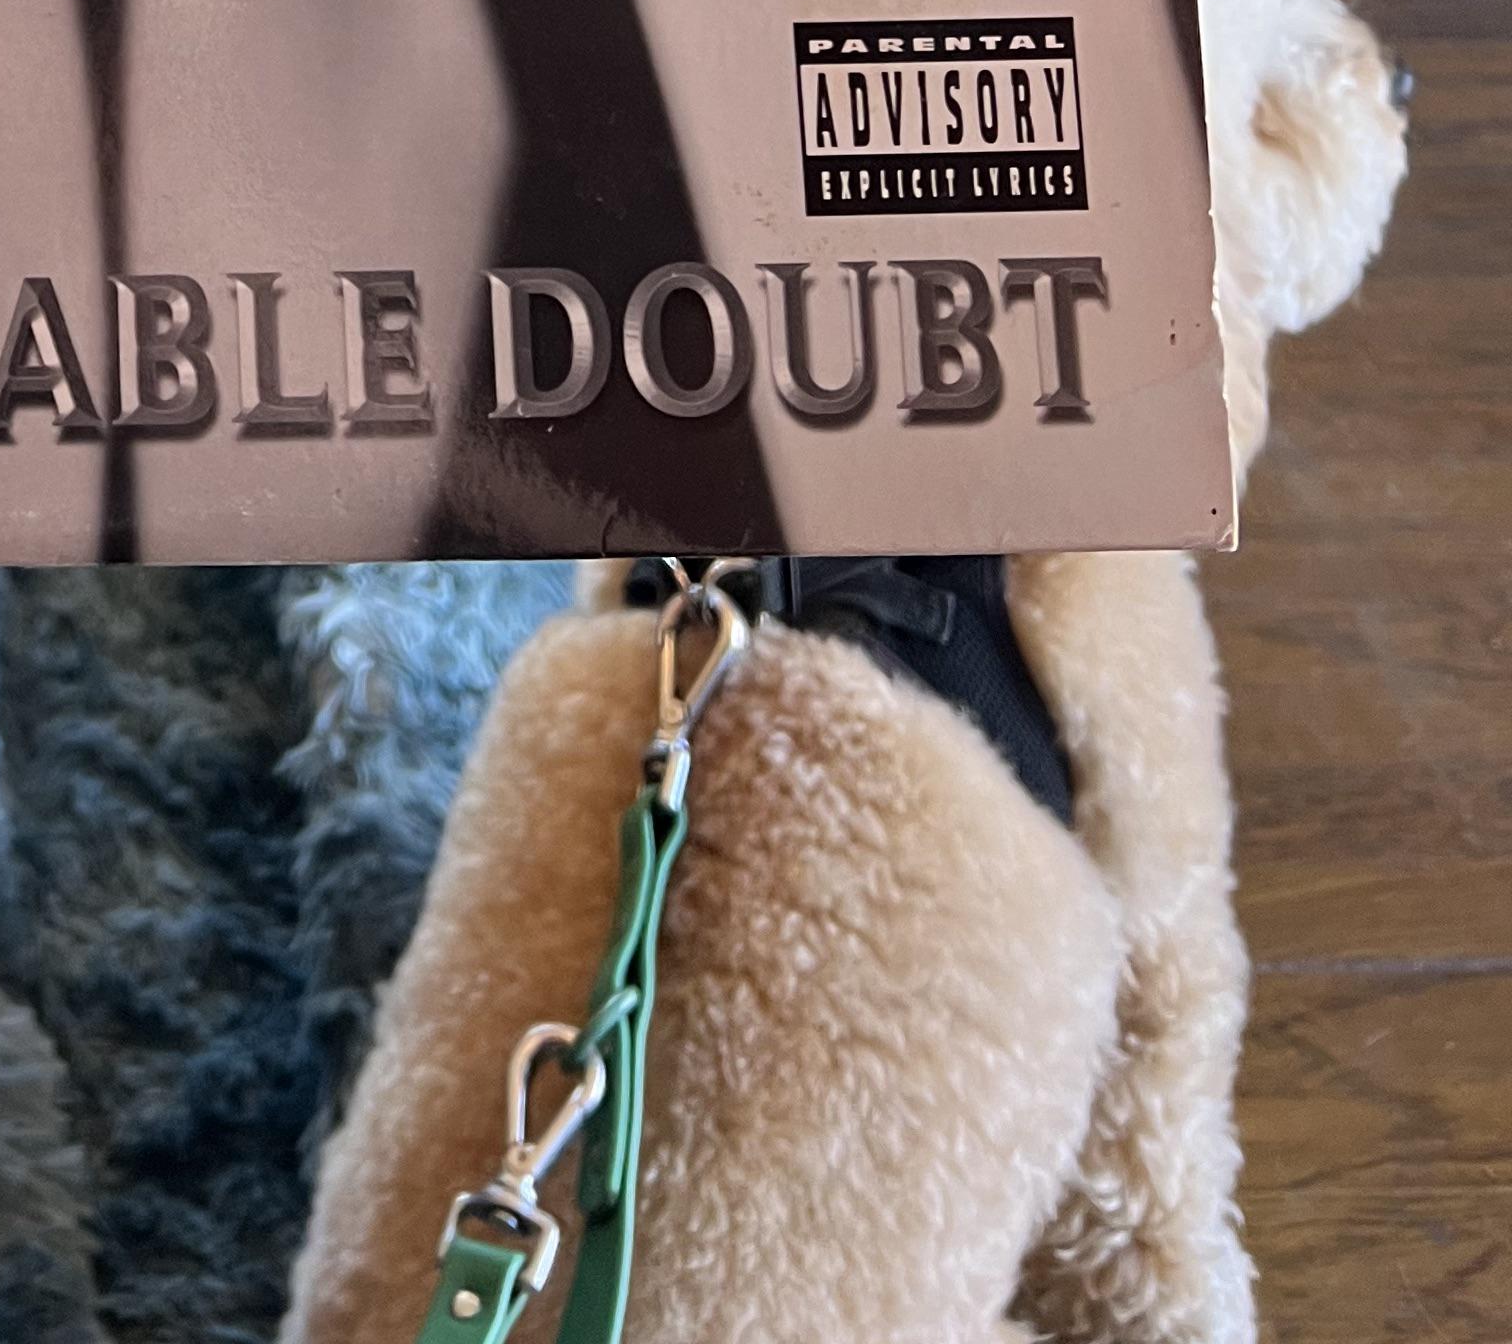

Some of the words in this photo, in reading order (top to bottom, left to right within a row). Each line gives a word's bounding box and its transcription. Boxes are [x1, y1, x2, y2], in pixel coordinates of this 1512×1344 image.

[807, 33, 1066, 55] PARENTAL
[815, 66, 1066, 149] ADVISORY
[820, 167, 956, 201] EXPLICIT
[971, 164, 1075, 198] LYRICS
[480, 256, 1110, 423] DOUBT
